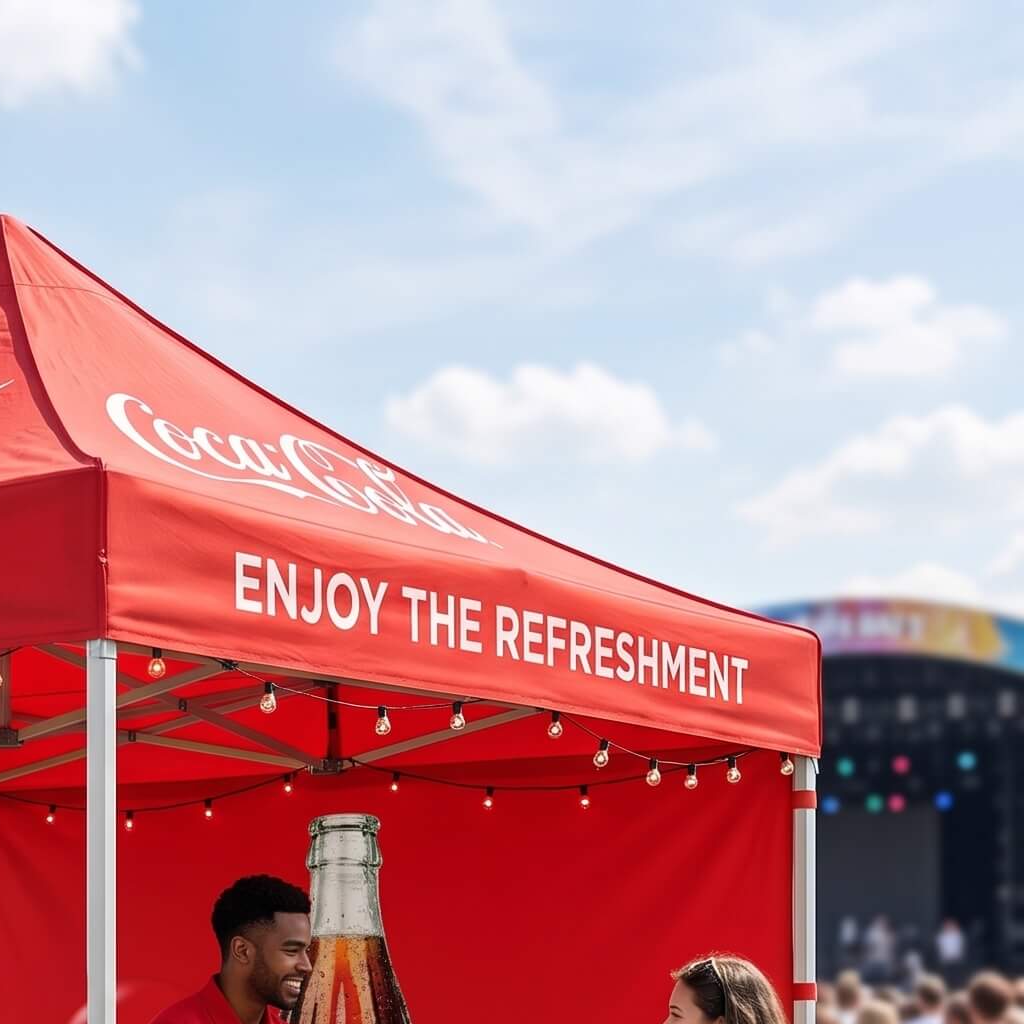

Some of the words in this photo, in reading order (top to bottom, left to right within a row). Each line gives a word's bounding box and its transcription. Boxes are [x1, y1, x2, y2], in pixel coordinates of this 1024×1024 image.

[235, 552, 388, 634] ENJOY
[402, 587, 482, 653] THE
[496, 605, 749, 704] REFRESHMENT
